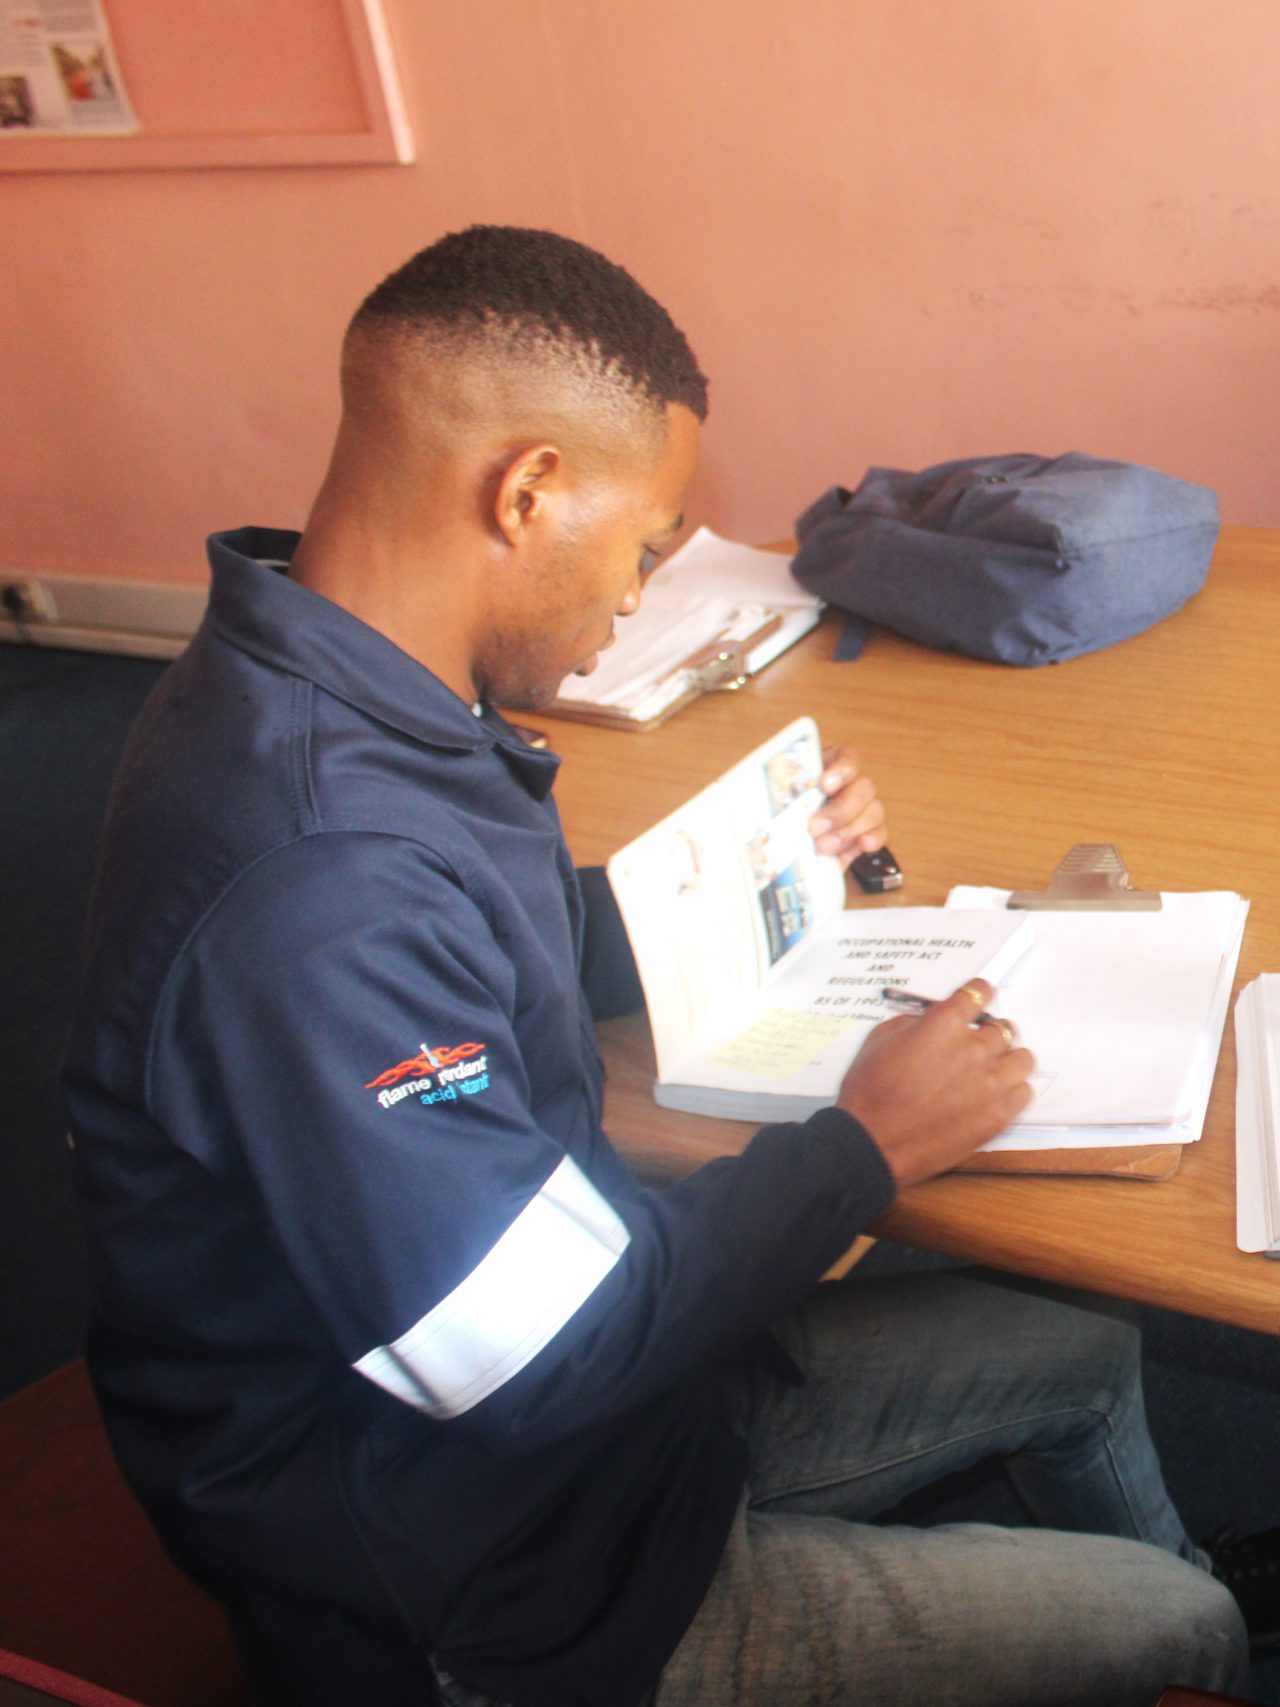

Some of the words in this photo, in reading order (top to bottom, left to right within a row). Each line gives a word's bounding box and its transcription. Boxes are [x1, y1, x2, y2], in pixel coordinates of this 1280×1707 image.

[927, 938, 976, 950] HEALTH
[845, 951, 872, 960] AND
[873, 951, 915, 961] SAFETY
[917, 951, 943, 961] ACT
[867, 963, 895, 973] AND
[827, 976, 911, 987] REGULATIONS
[377, 1077, 432, 1108] flame
[420, 1085, 457, 1105] acid
